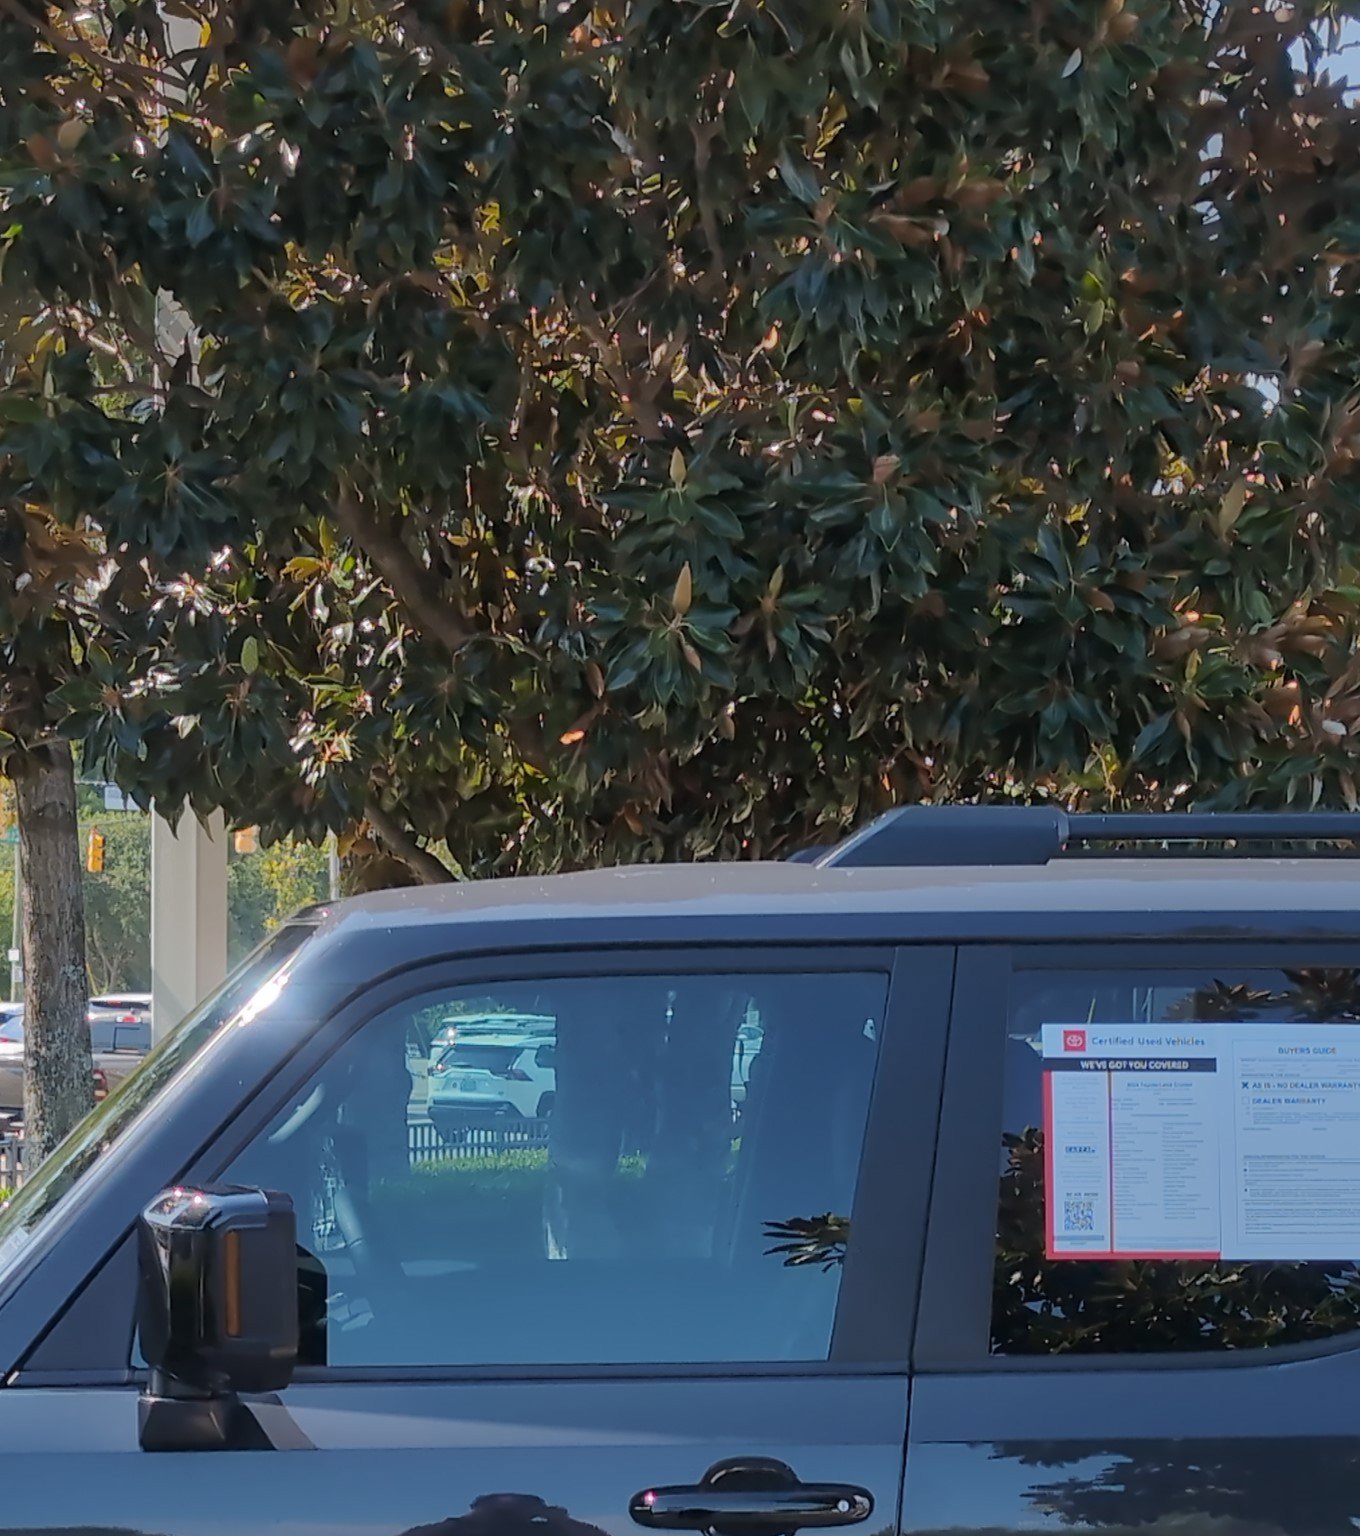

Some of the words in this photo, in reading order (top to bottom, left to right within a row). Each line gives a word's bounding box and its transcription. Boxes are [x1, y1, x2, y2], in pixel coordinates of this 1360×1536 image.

[1091, 1036, 1135, 1046] Certified
[1137, 1036, 1162, 1046] Used
[1165, 1036, 1205, 1046] Vehicles
[1277, 1046, 1311, 1054] BUYERS
[1312, 1046, 1337, 1054] GUIDE
[1080, 1060, 1107, 1069] WE'VE
[1108, 1060, 1127, 1069] GOT
[1128, 1060, 1148, 1069] YOU
[1148, 1060, 1189, 1069] COVERED
[1252, 1081, 1262, 1089] AS
[1264, 1081, 1271, 1089] IS
[1277, 1081, 1288, 1089] NO
[1289, 1081, 1319, 1089] DEALER
[1252, 1097, 1282, 1105] DEALER
[1284, 1097, 1326, 1105] WARRANTY
